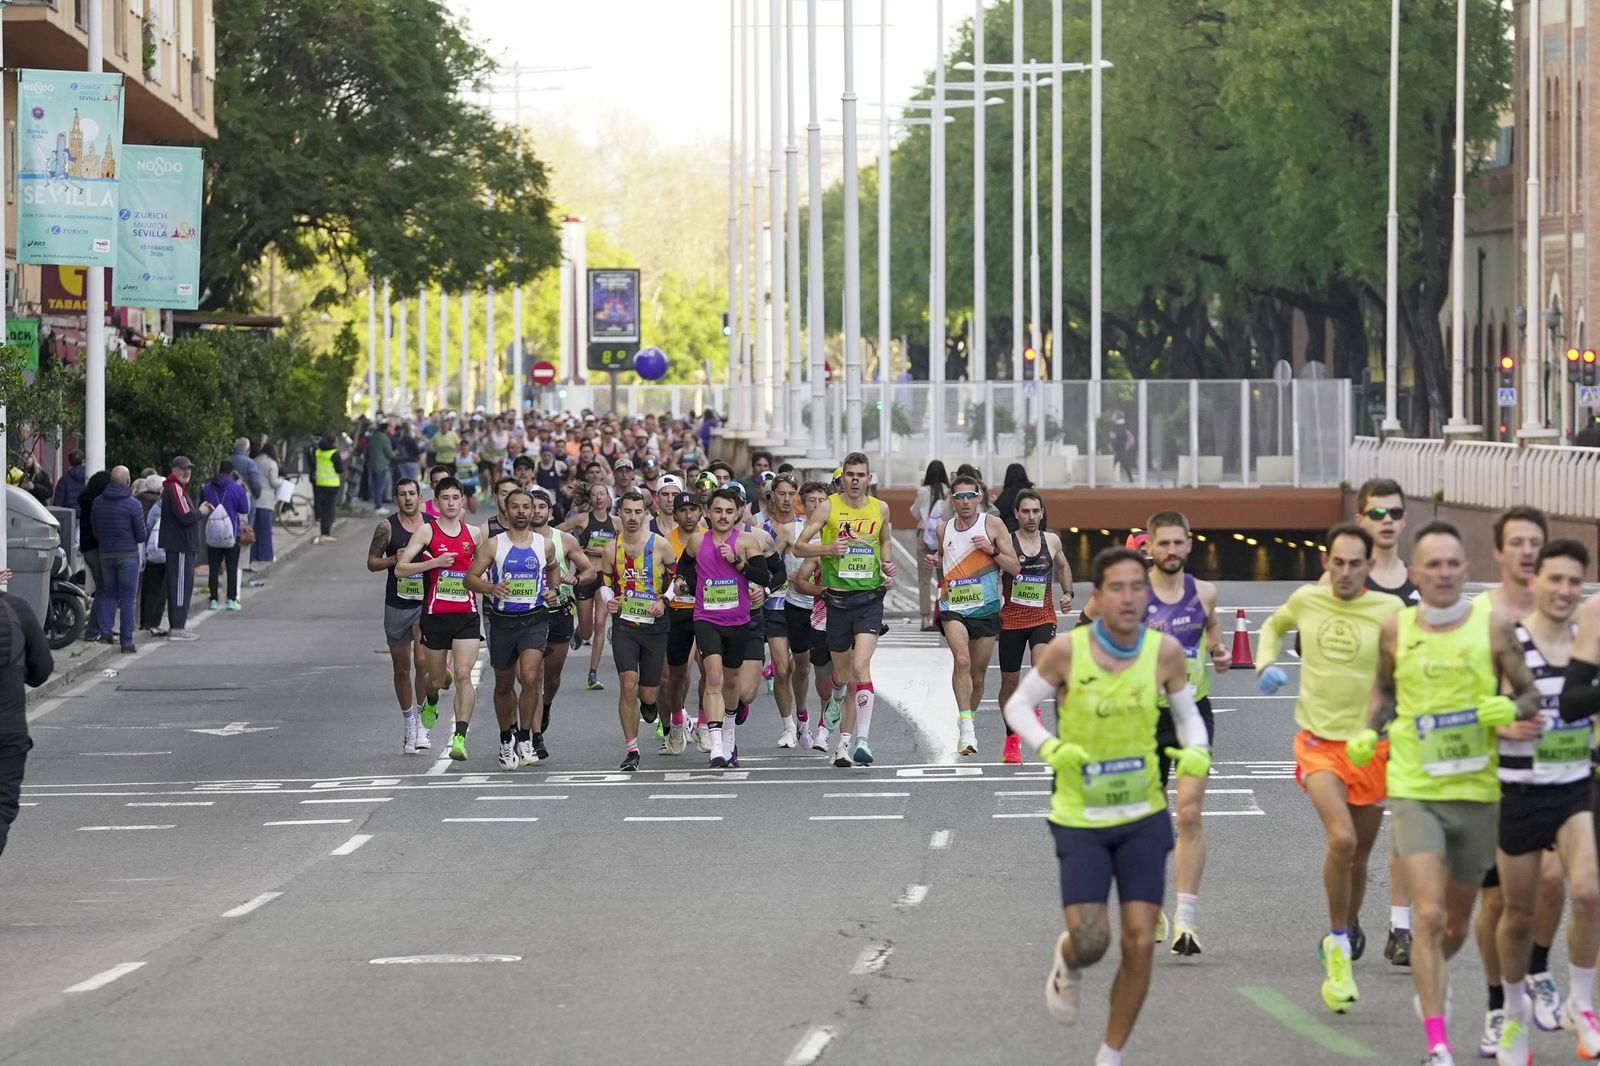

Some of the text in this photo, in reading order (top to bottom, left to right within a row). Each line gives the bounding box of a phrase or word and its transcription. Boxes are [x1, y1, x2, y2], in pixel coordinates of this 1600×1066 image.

[24, 184, 114, 208] SEVILLA
[134, 212, 167, 220] ZURICH
[133, 229, 168, 238] SEVILLA
[48, 299, 108, 311] TABACS
[6, 331, 32, 340] OCK
[629, 607, 647, 615] CLEM
